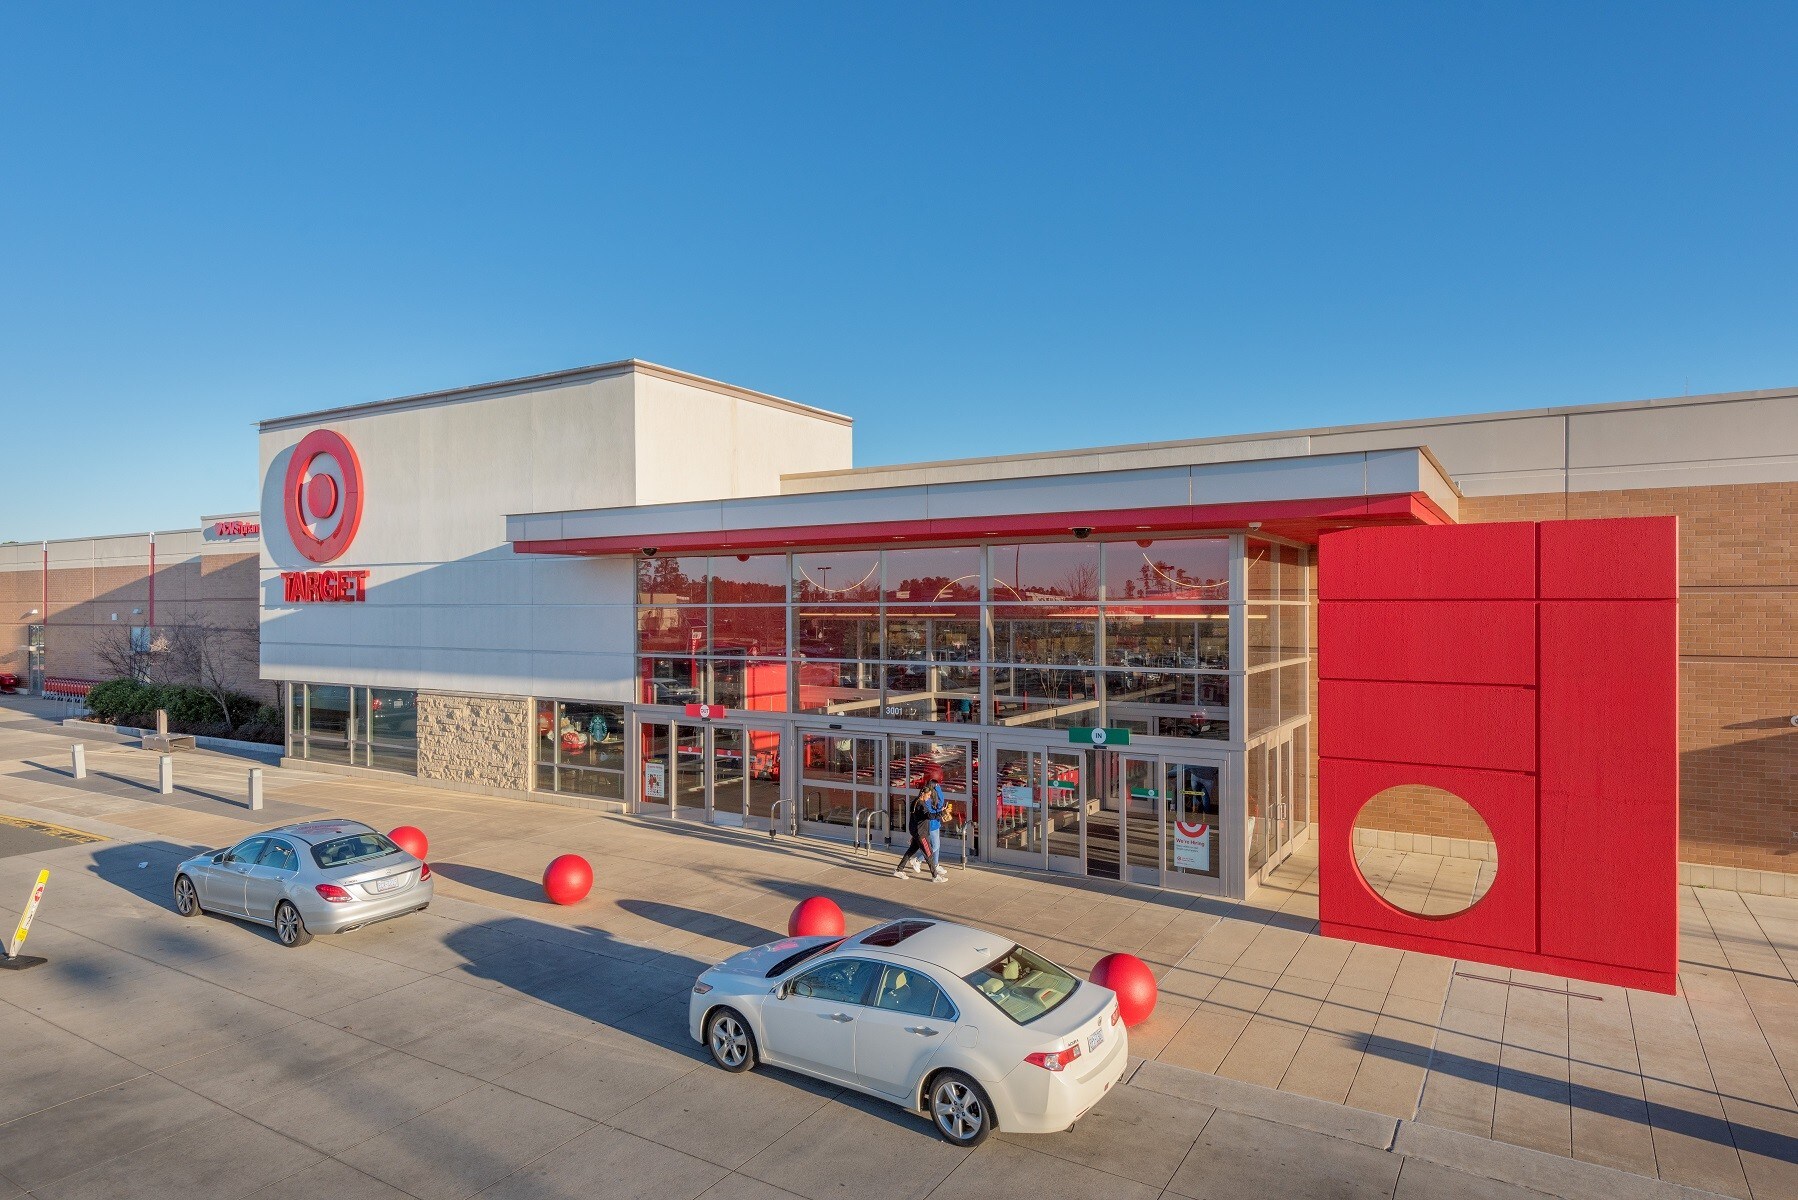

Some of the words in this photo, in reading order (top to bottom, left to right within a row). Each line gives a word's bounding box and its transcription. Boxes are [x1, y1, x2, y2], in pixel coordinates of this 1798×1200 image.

[281, 570, 370, 602] TARGET
[885, 706, 903, 715] 3001
[1175, 837, 1190, 845] We're
